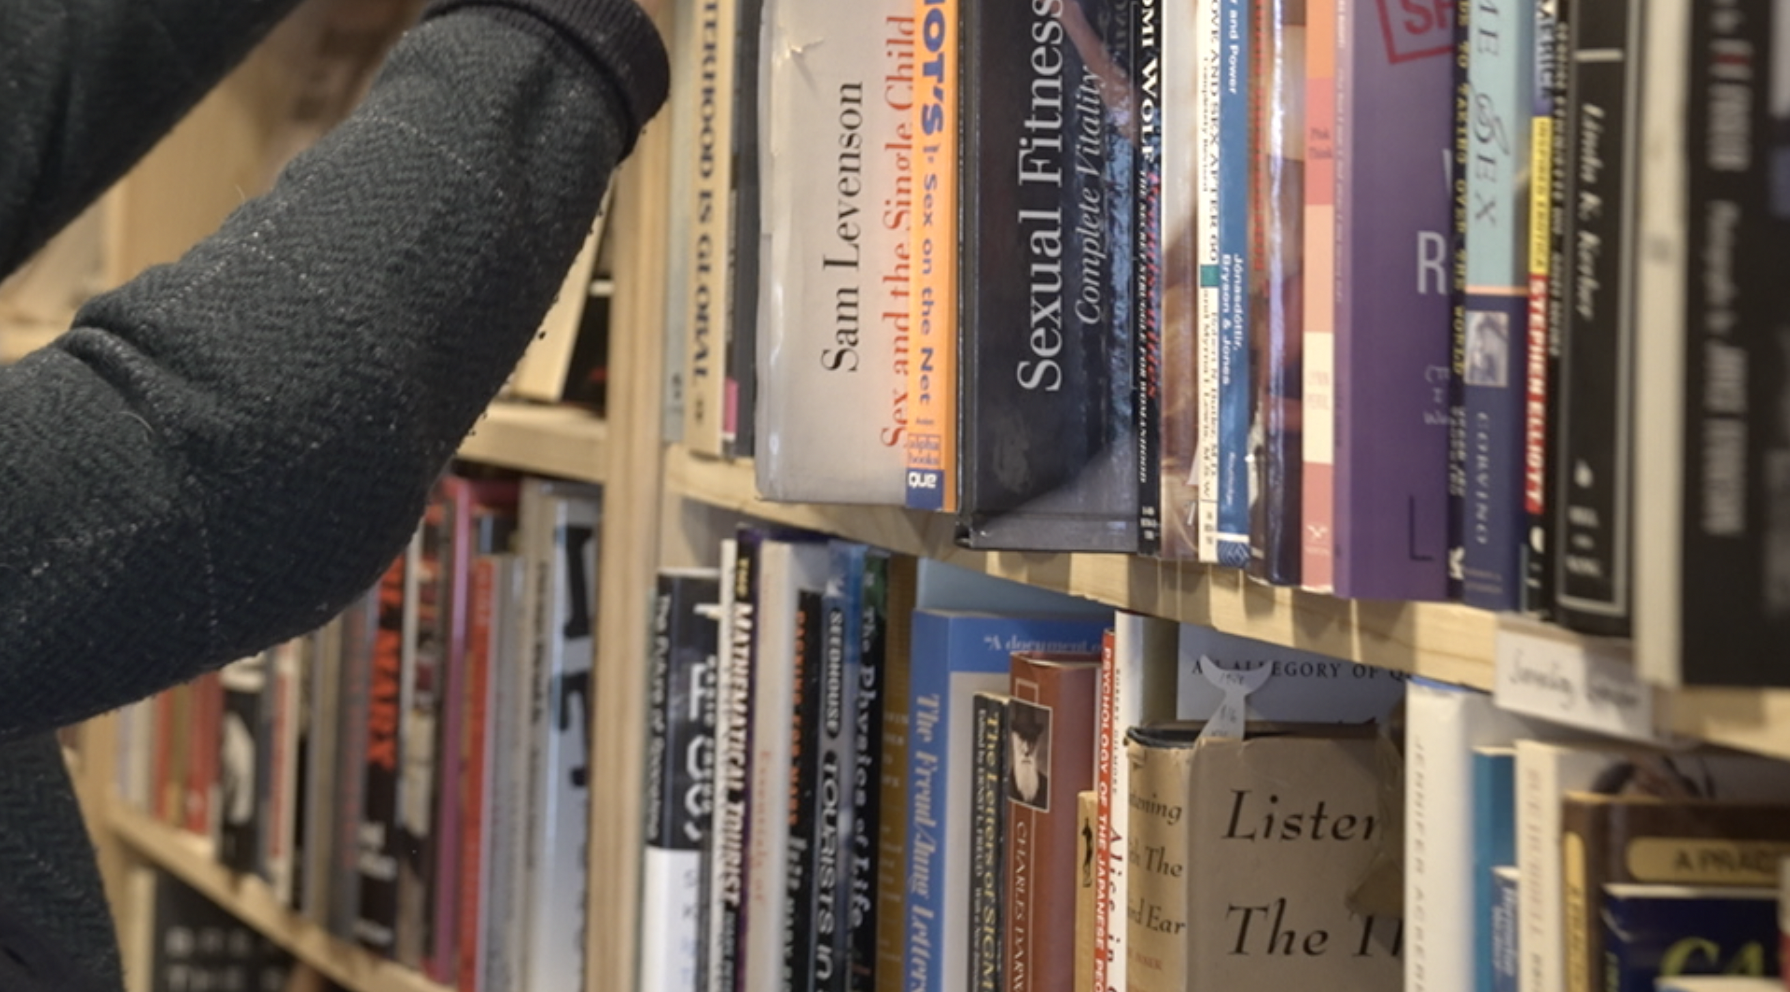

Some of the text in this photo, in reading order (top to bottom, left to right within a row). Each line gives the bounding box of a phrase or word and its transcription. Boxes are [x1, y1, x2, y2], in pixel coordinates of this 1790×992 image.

[1228, 10, 1240, 39] and
[884, 16, 915, 112] Child
[1228, 45, 1240, 95] Power
[1140, 57, 1159, 165] WOLF
[883, 122, 914, 232] Single
[1468, 80, 1512, 228] SEX
[697, 189, 715, 224] IS
[821, 81, 865, 373] Sam Levenson
[923, 173, 938, 229] Sex
[1074, 64, 1108, 325] Complete Vitality
[882, 242, 912, 299] the
[922, 238, 935, 276] on
[1220, 253, 1233, 315] Bryson
[691, 233, 713, 388] GLOBAL
[921, 287, 934, 336] the
[1015, 207, 1063, 392] Sexual
[1233, 253, 1246, 351] Jónasdóttir,
[882, 309, 911, 376] and
[1222, 336, 1233, 385] Jones
[919, 346, 935, 407] Net
[1525, 277, 1547, 506] STEPHEN ELLIOTT
[725, 602, 753, 790] MATHEMATICAL
[1352, 663, 1380, 679] OF
[915, 694, 940, 743] The
[985, 712, 1000, 767] The
[1099, 646, 1113, 772] PSYCHOLOGY
[851, 607, 878, 929] The Physics of Life
[1098, 782, 1109, 808] OF
[817, 760, 841, 935] TOURISTS
[908, 750, 939, 900] Freud/Jung
[984, 772, 999, 867] Letters
[1097, 813, 1109, 850] THE
[721, 801, 745, 907] TOURIST
[1015, 820, 1028, 921] CHARLES
[1145, 846, 1183, 878] The
[983, 872, 998, 904] of
[1095, 854, 1108, 951] JAPANESE
[1146, 905, 1187, 935] Ear
[1226, 897, 1330, 959] The
